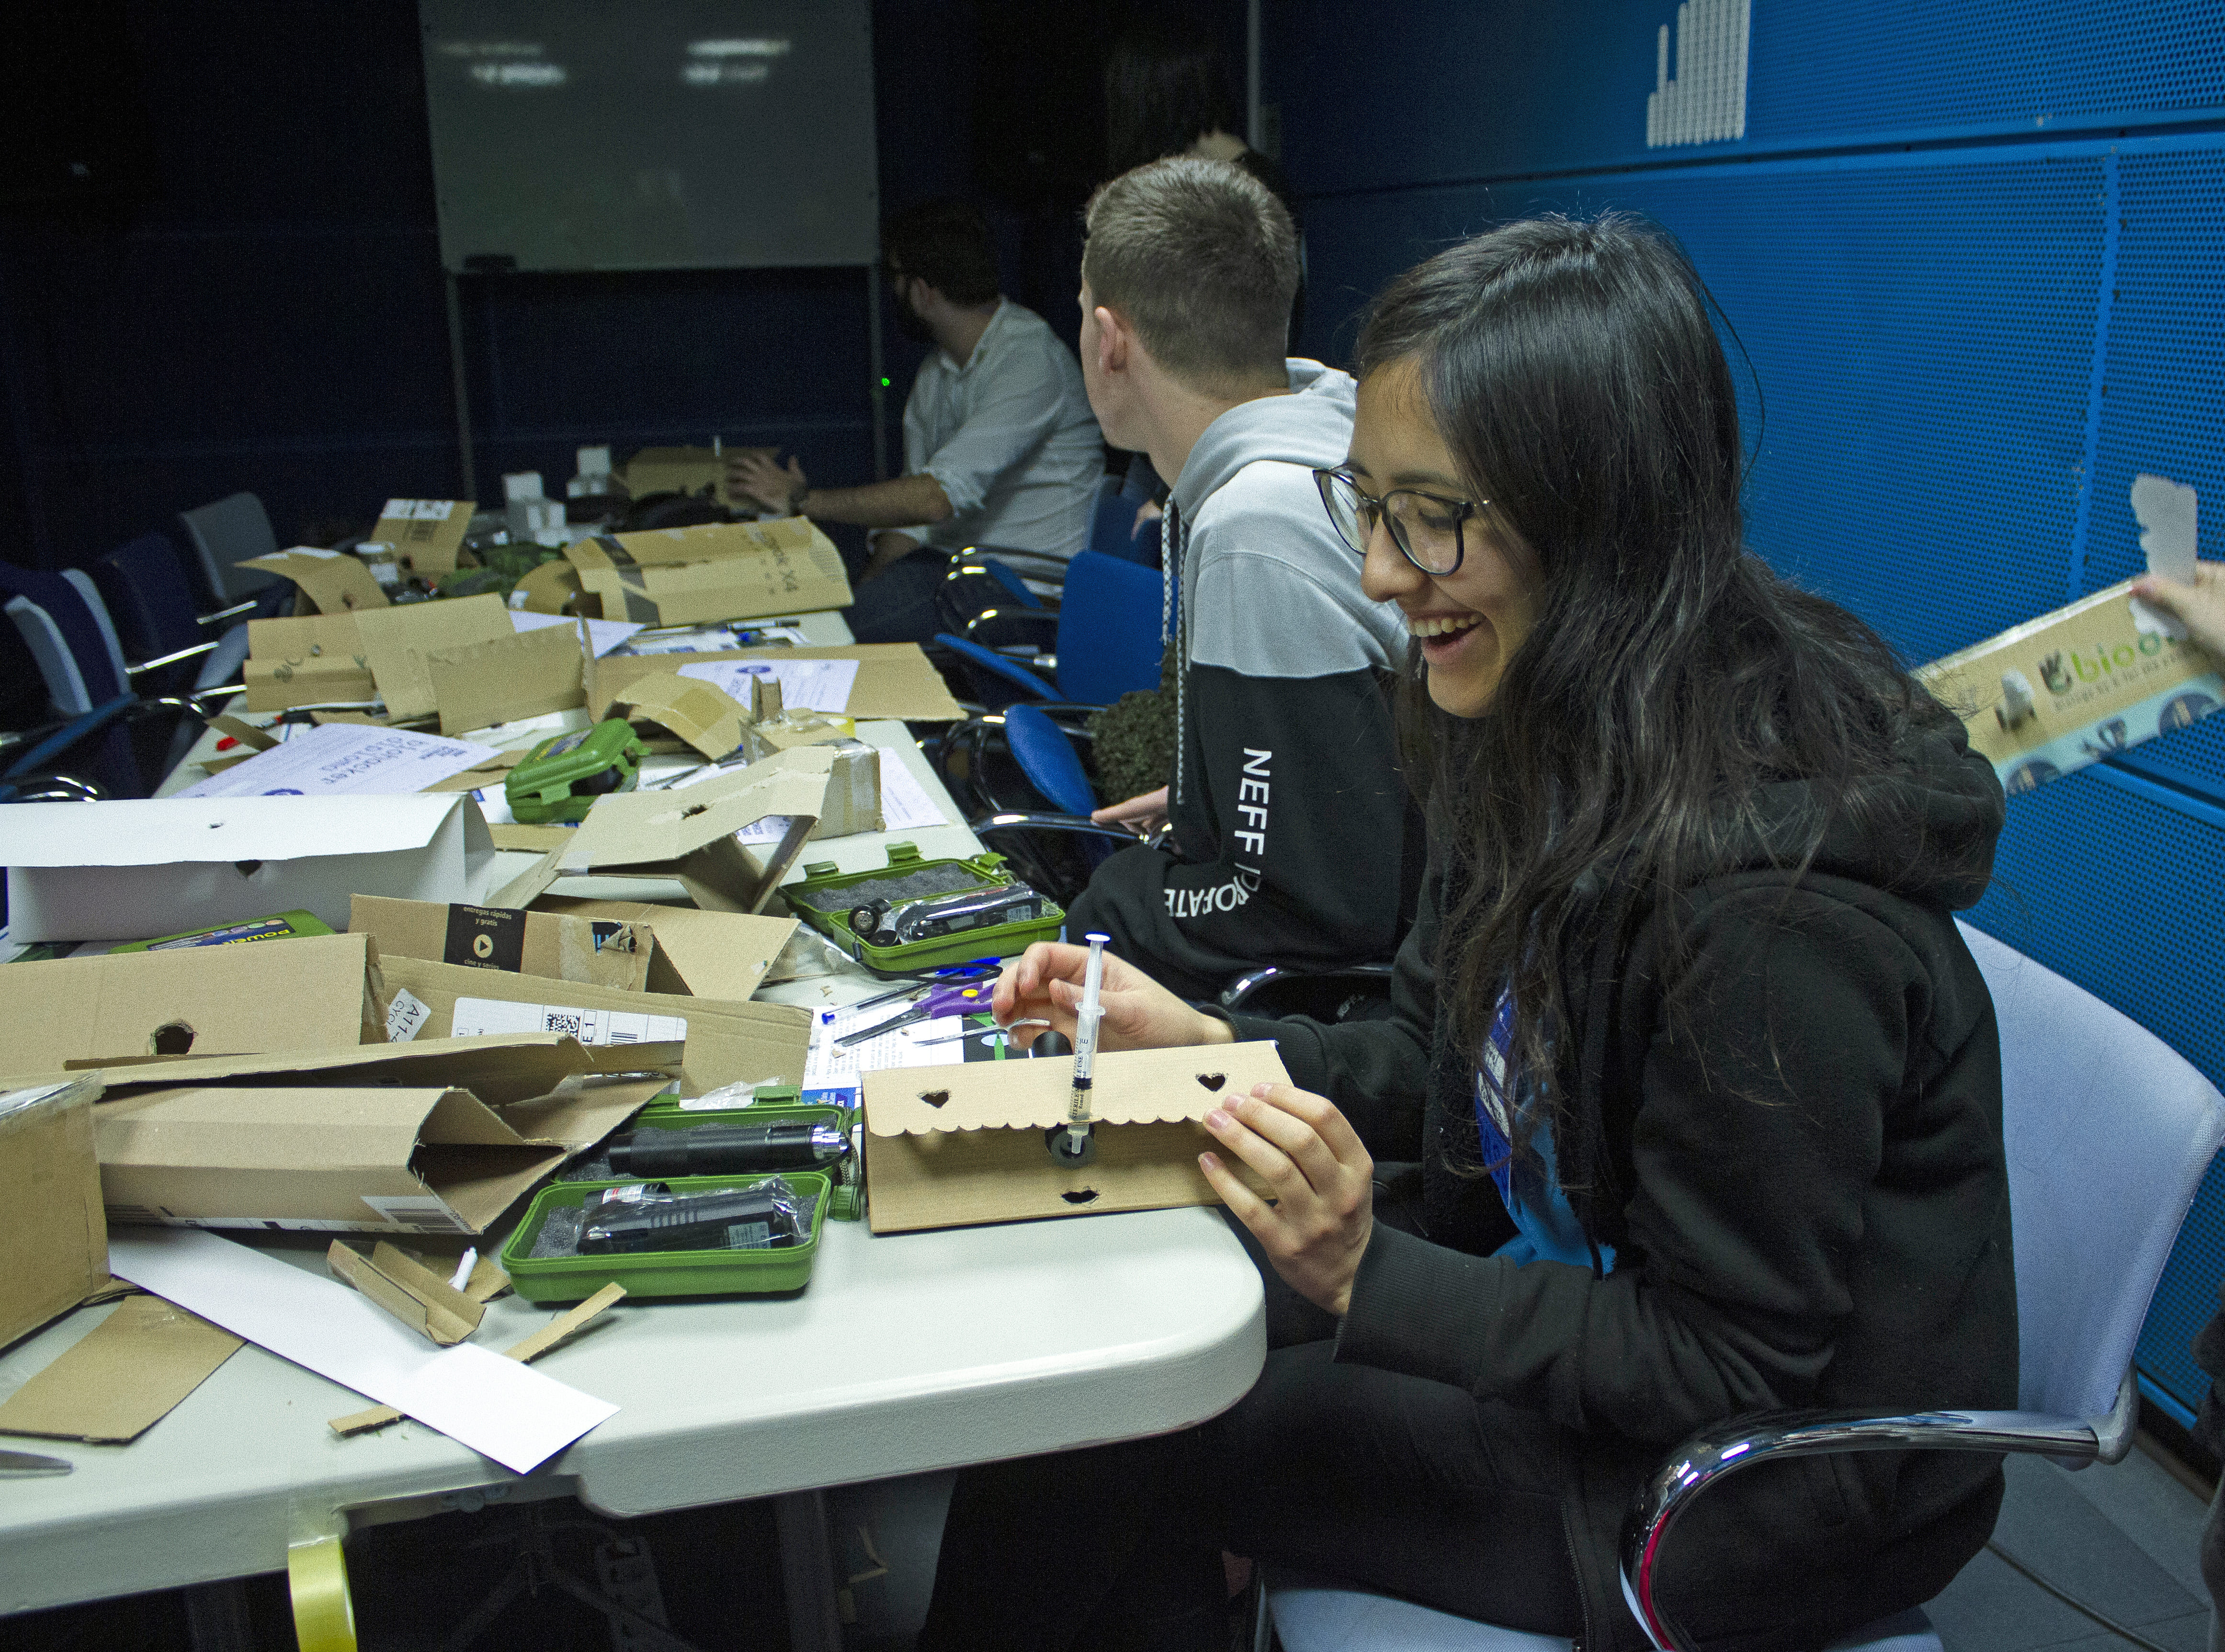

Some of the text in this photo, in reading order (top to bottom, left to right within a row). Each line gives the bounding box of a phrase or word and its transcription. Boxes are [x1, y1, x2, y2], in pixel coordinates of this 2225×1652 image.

[1235, 747, 1272, 855] NEFF
[463, 906, 489, 916] entregas
[480, 918, 498, 927] gratis
[464, 958, 477, 966] cine
